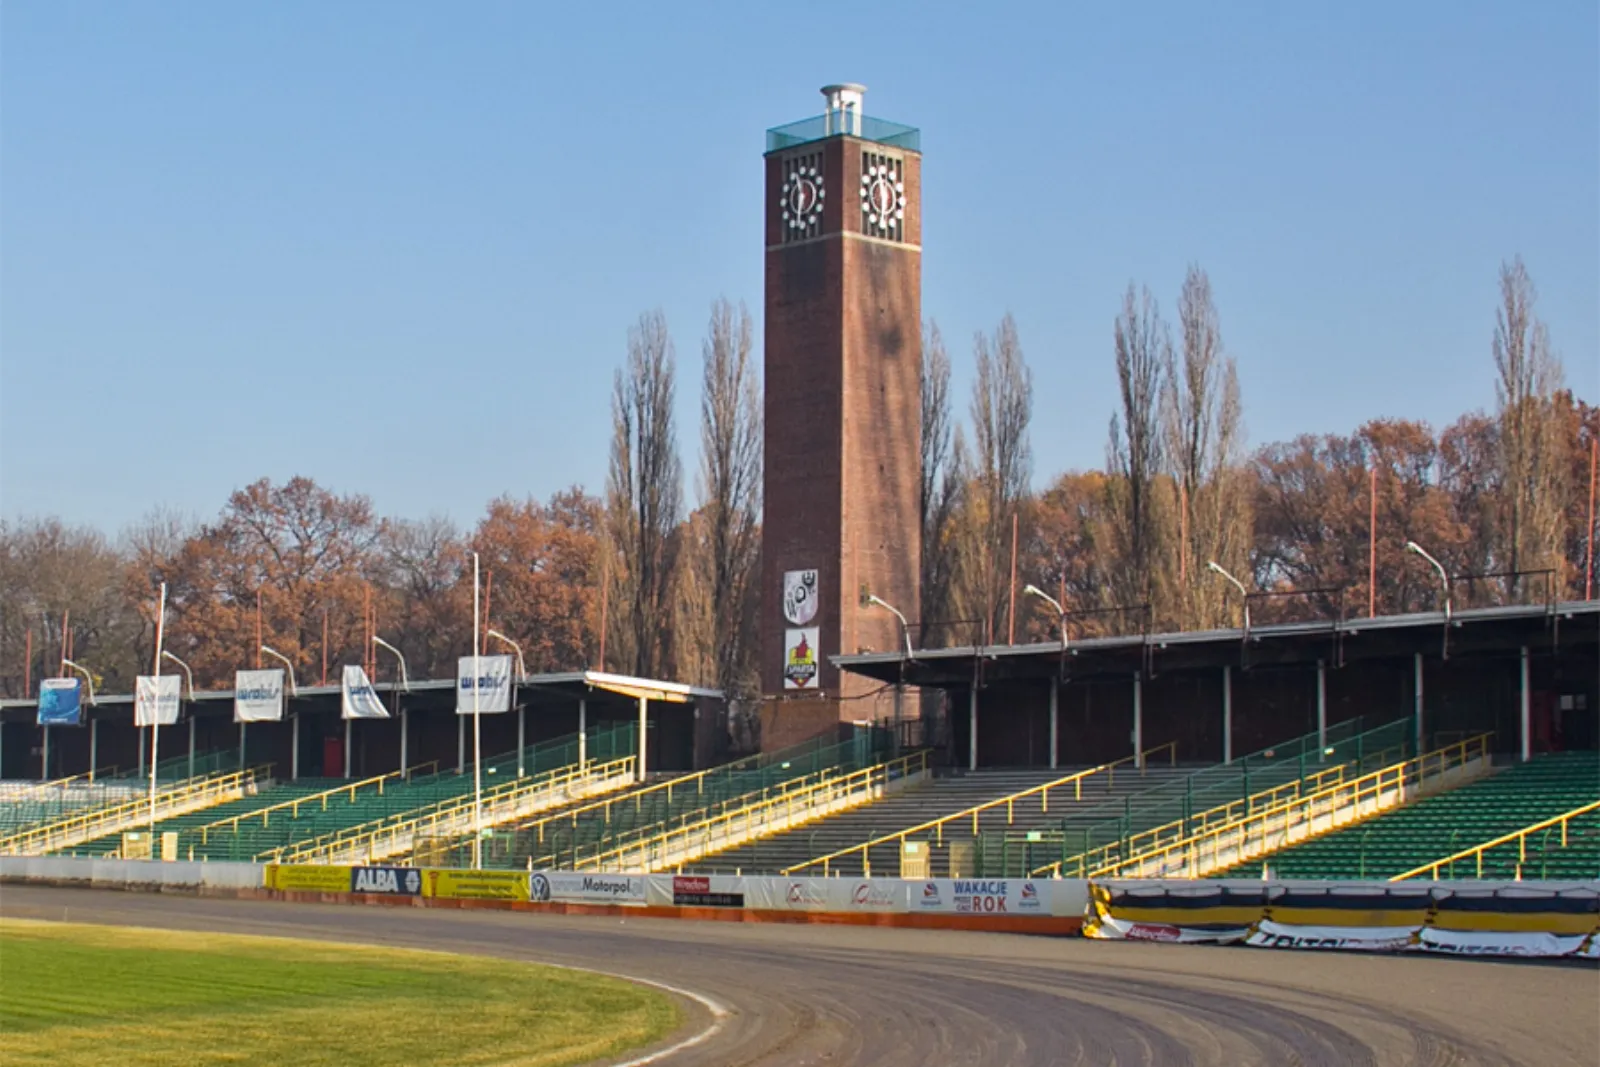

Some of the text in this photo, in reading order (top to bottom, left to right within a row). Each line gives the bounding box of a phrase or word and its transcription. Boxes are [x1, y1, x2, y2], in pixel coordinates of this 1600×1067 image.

[355, 869, 399, 892] ALBA
[953, 881, 1008, 895] WAKACJE
[973, 896, 1007, 912] ROK
